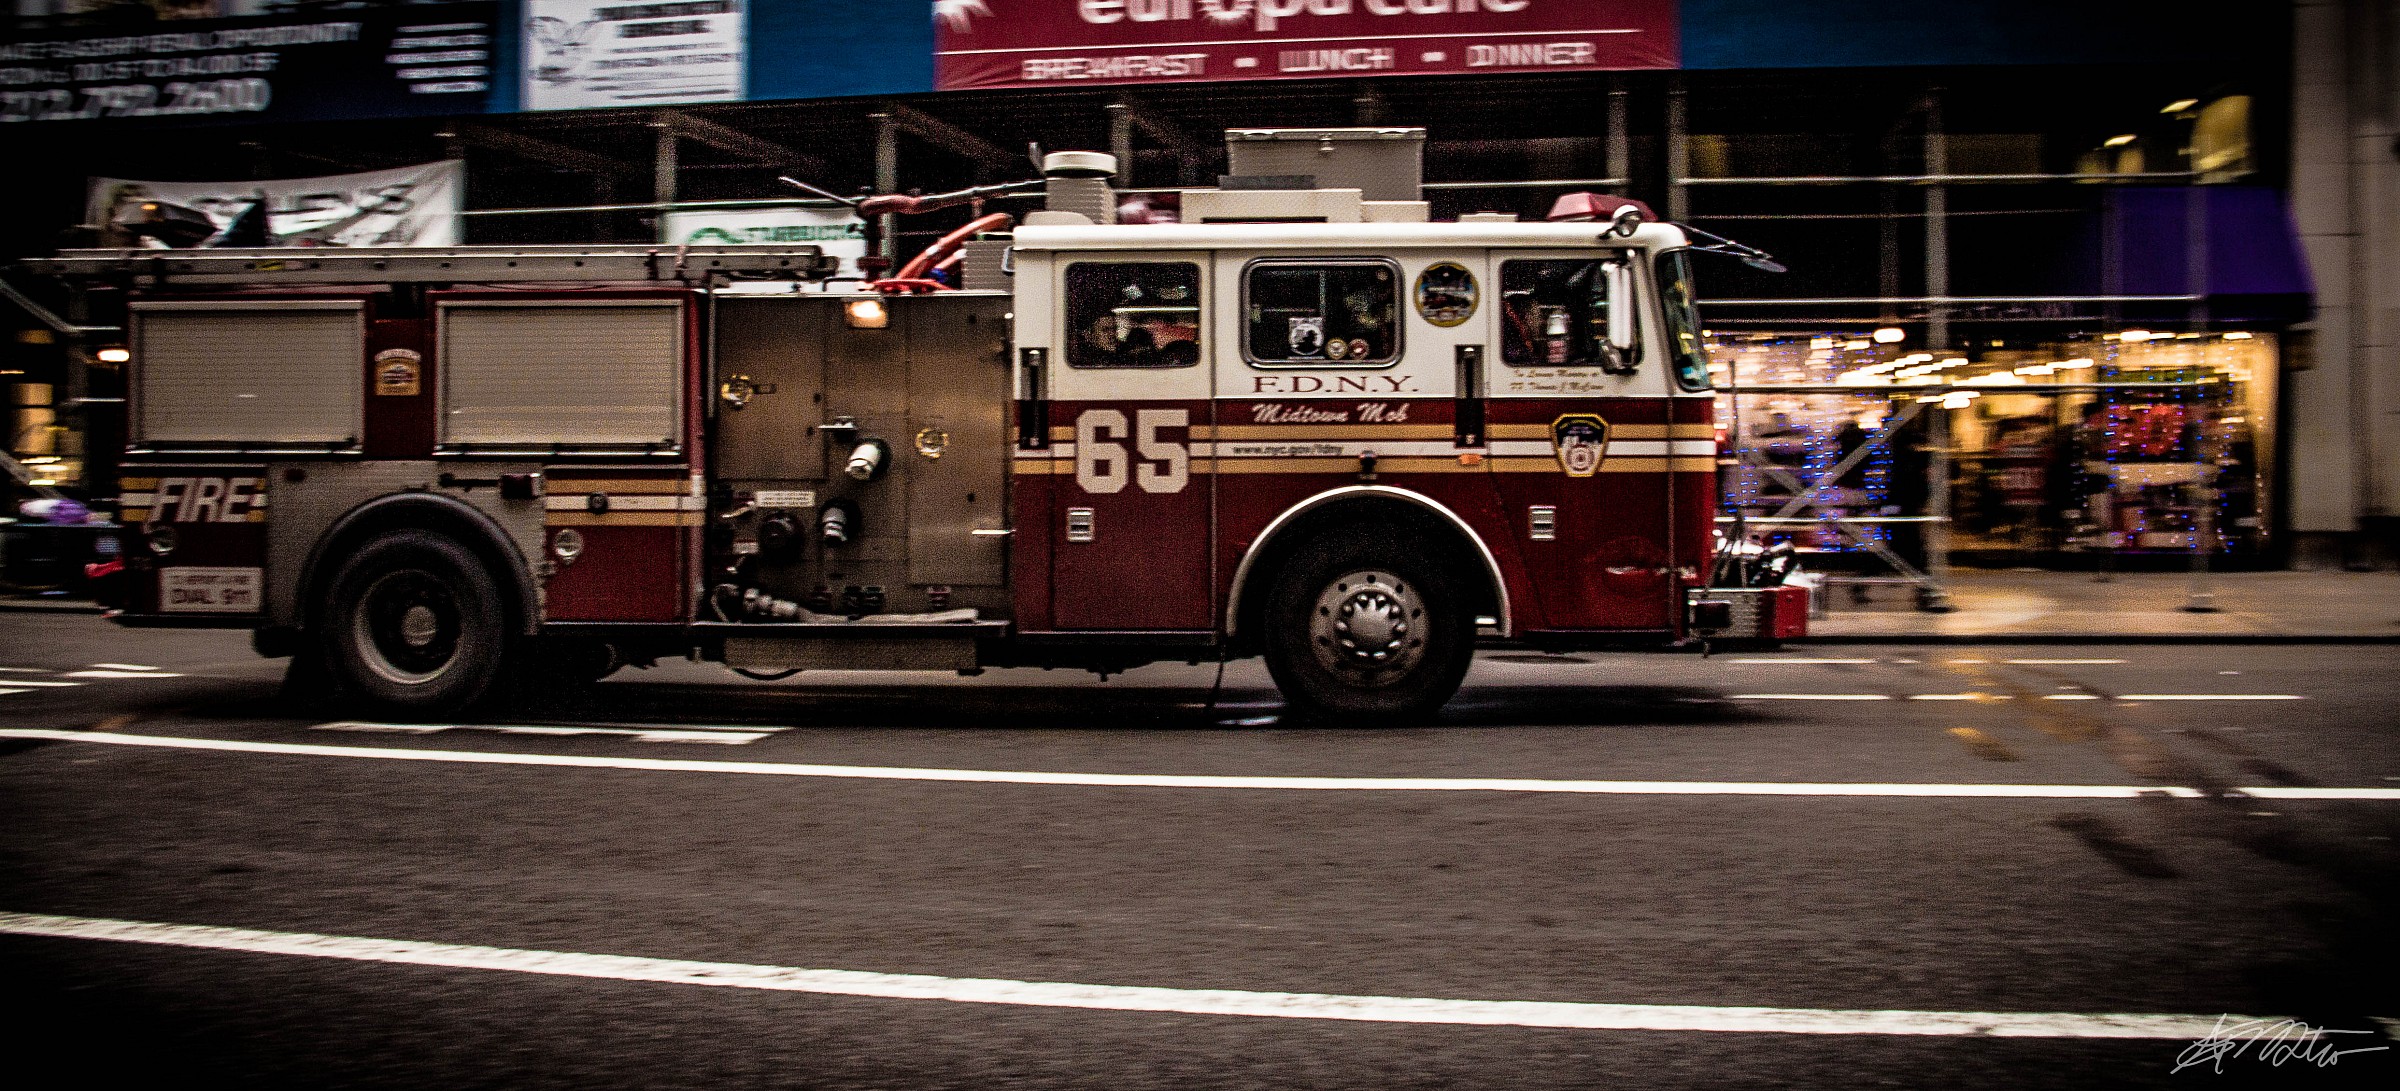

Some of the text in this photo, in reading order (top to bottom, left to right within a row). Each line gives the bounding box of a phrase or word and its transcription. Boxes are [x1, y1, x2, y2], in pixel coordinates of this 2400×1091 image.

[1021, 42, 1597, 80] BREAKFAST LUNCH DINNER
[1252, 375, 1419, 393] F.D.N.Y.
[1252, 402, 1410, 423] Midtown Mob
[1075, 409, 1190, 494] 65
[149, 477, 259, 522] FIRE
